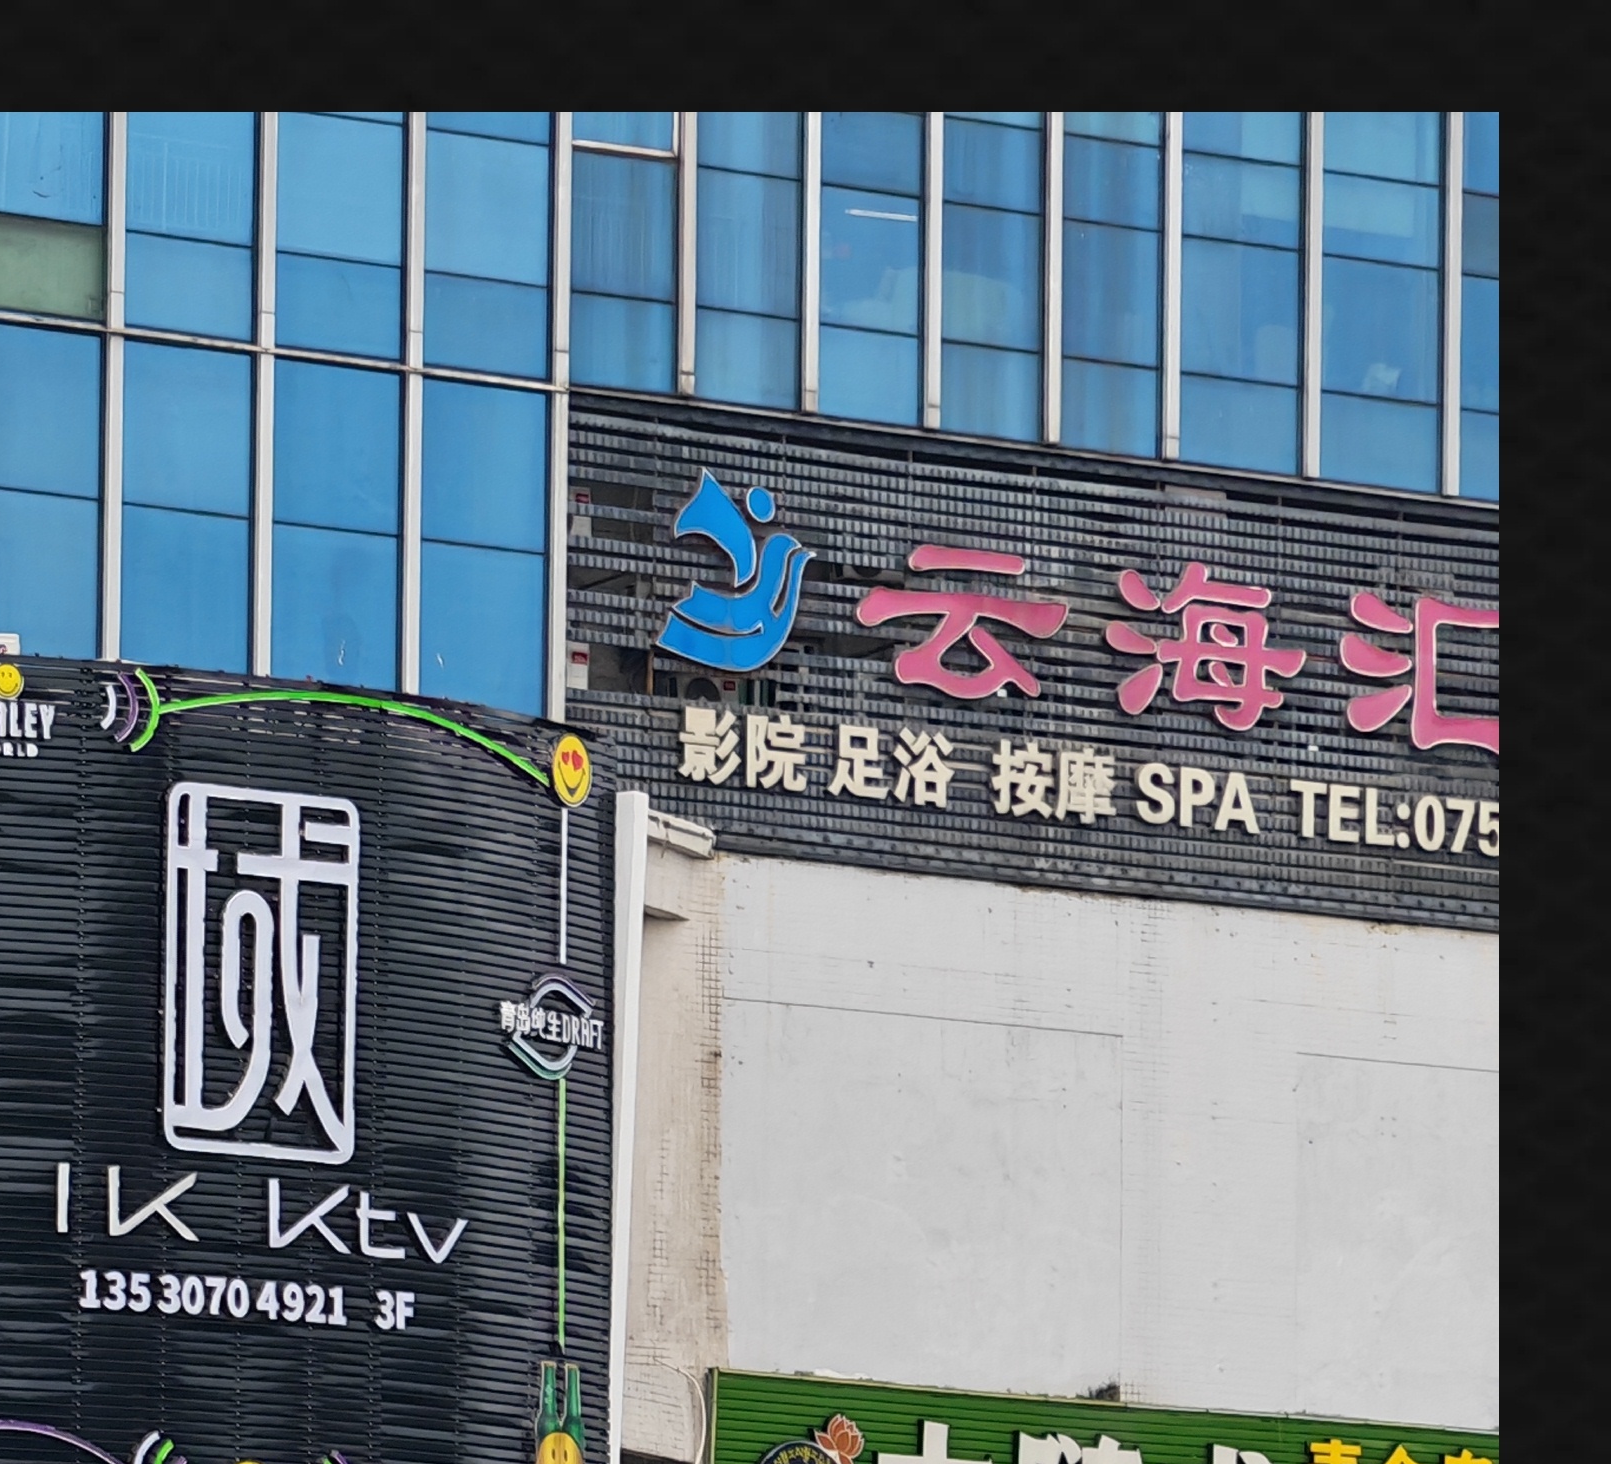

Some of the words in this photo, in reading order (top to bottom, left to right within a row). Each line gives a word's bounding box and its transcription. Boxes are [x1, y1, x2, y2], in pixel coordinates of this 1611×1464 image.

[855, 542, 1499, 752] 云海汇
[677, 705, 808, 793] 影院
[827, 723, 955, 808] 足浴
[991, 739, 1119, 827] 按摩
[1136, 760, 1262, 837] SPA
[79, 1269, 151, 1312] 135
[156, 1275, 250, 1318] 3070
[254, 1281, 347, 1327] 4921
[374, 1289, 416, 1331] 3F
